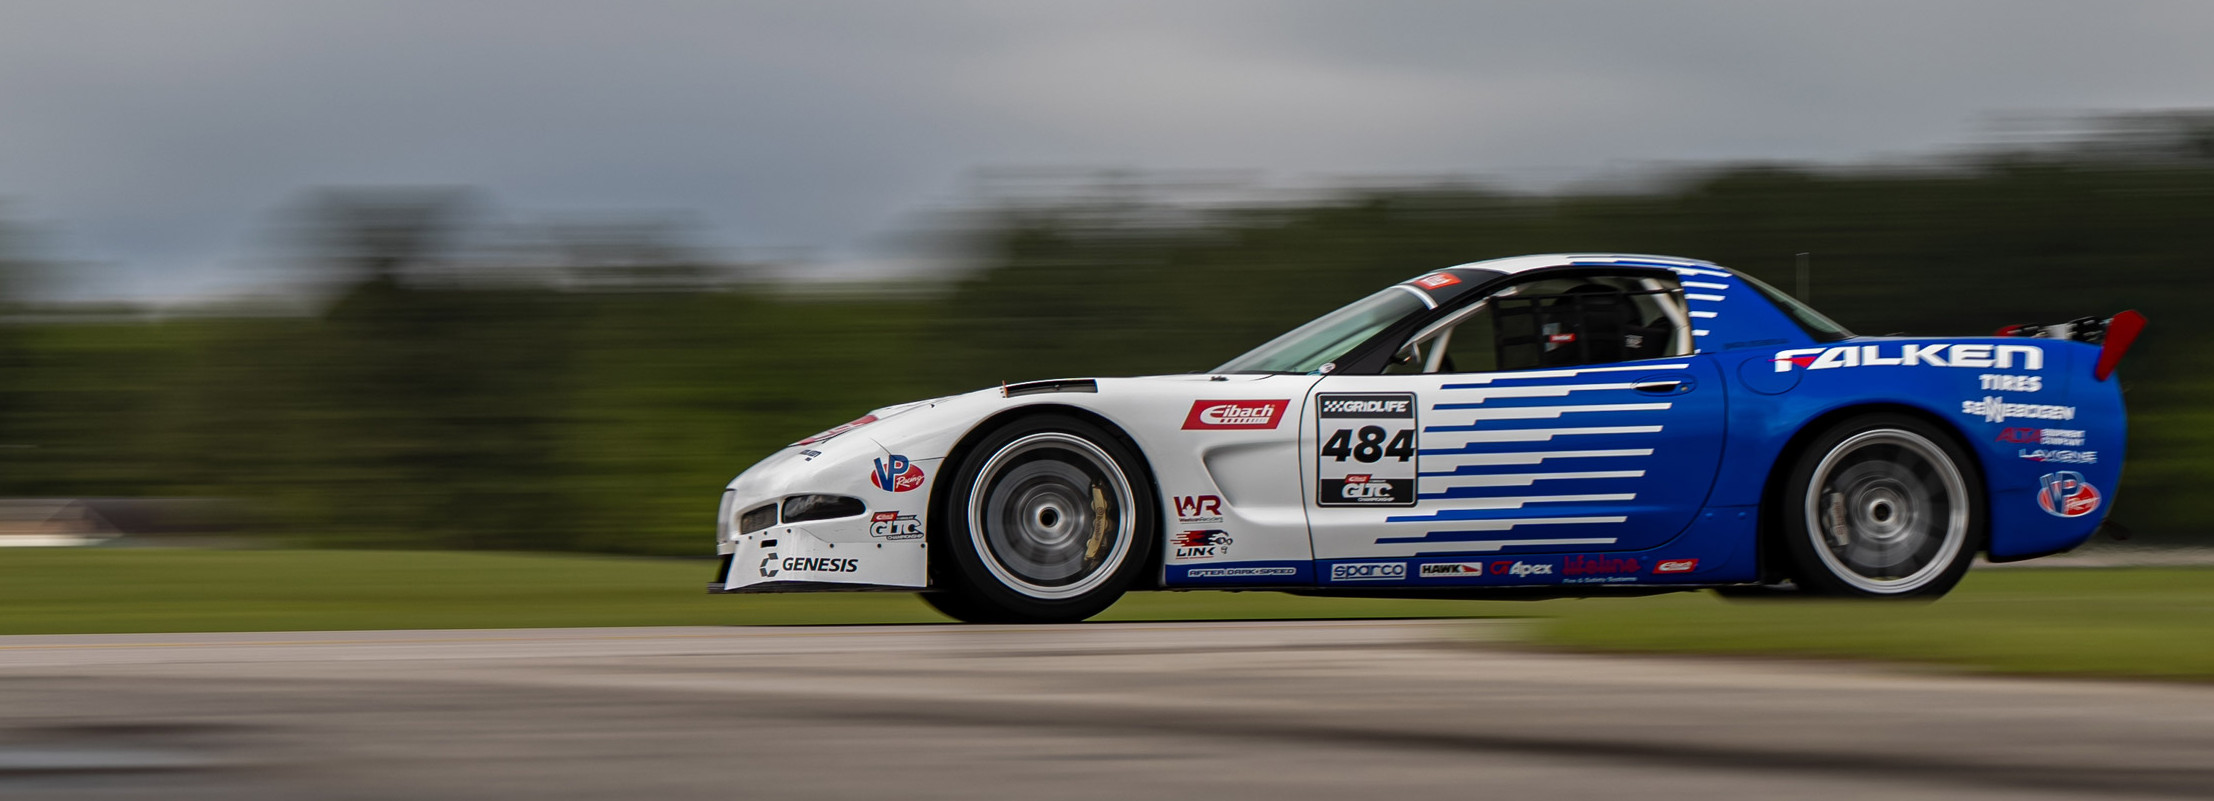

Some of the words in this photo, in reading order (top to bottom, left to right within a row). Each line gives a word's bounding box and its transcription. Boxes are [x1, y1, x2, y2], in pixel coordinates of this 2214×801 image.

[1774, 344, 2044, 372] FALKEN
[1979, 374, 2043, 392] TIRES
[1200, 404, 1275, 425] Eibach
[1342, 400, 1410, 413] GRIDLIFE
[1321, 425, 1417, 463] 484
[873, 455, 909, 492] VP
[896, 474, 926, 489] Racing
[2039, 471, 2086, 515] VP
[1173, 495, 1222, 517] WR
[1176, 547, 1216, 557] LINK
[782, 557, 859, 573] GENESIS
[1333, 564, 1405, 579] sparco
[1422, 564, 1462, 574] HAWK
